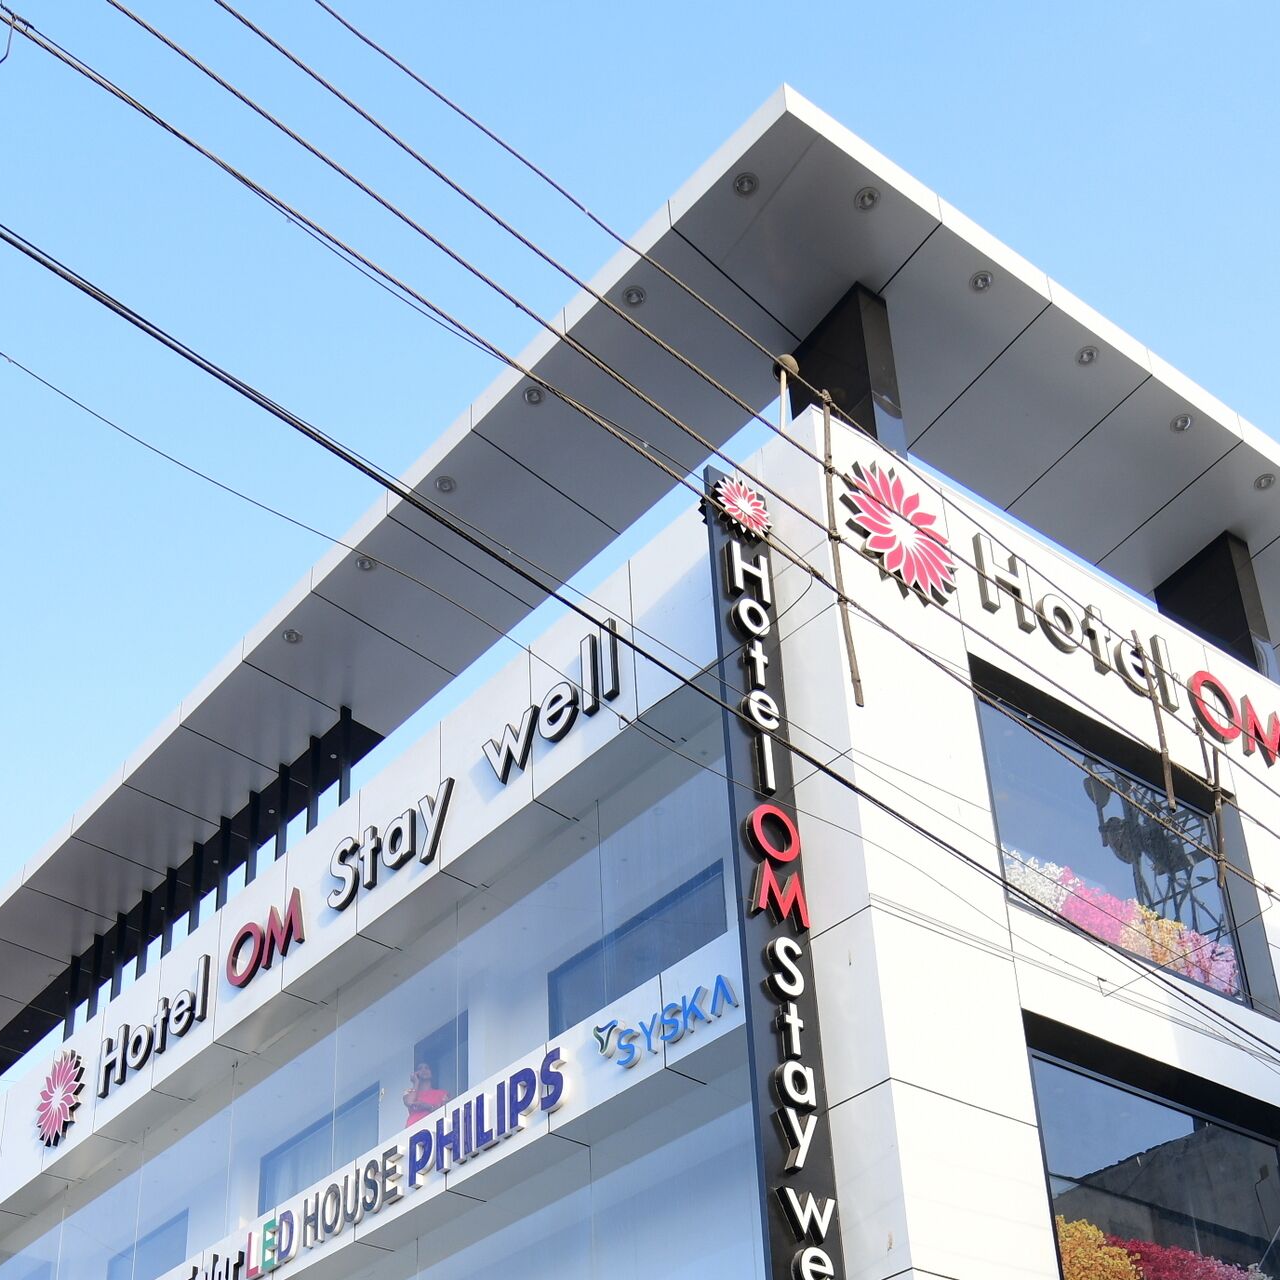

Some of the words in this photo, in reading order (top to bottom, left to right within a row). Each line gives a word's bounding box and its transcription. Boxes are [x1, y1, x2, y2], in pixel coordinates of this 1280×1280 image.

[723, 540, 782, 796] Hotel
[972, 532, 1180, 713] Hotel
[98, 954, 210, 1098] Hotel
[227, 888, 306, 988] OM
[327, 776, 456, 911] Stay
[482, 617, 621, 784] well
[746, 804, 810, 931] OM
[303, 1144, 404, 1249] HOUSE
[408, 1046, 568, 1189] PHILIPS
[615, 973, 742, 1069] SYSKA
[765, 936, 818, 1172] Stay
